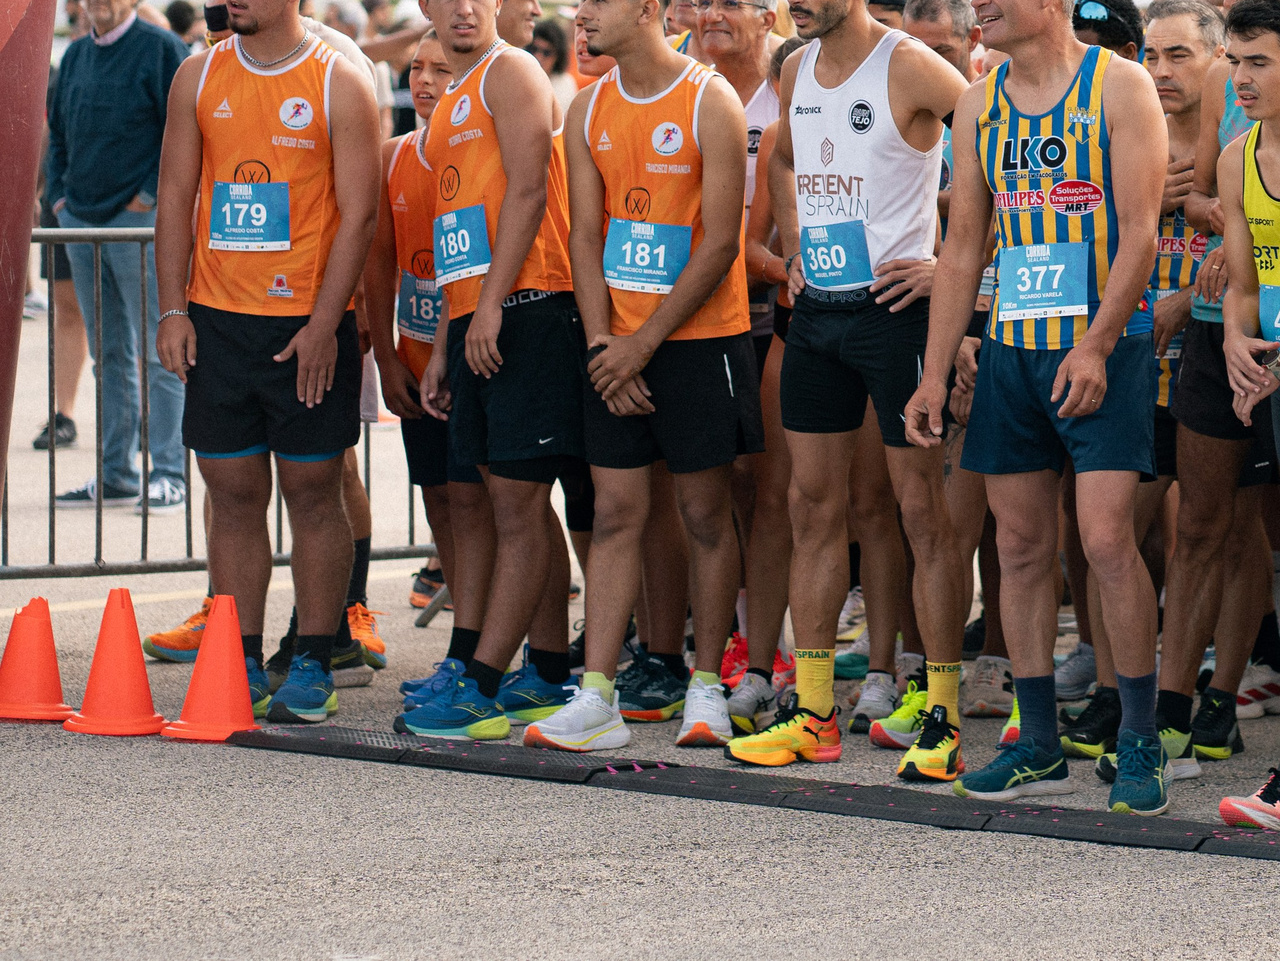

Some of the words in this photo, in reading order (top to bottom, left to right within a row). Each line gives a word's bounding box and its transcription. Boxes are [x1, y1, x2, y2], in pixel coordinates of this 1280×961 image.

[851, 115, 870, 125] TEJO
[462, 128, 484, 142] COSTA
[271, 135, 297, 148] ALFREDO
[297, 138, 316, 150] COSTA
[597, 143, 612, 151] SELECT
[1001, 135, 1068, 172] LKO
[645, 162, 668, 174] FRANCISCO
[668, 164, 691, 174] MIRANDA
[1000, 173, 1027, 181] FORMAÇÃO
[1056, 186, 1094, 195] Soluções
[1050, 193, 1101, 203] Transportes
[806, 194, 869, 220] SPRAIN
[1064, 202, 1090, 213] MRT
[222, 203, 267, 226] 179
[1255, 218, 1275, 227] SPORT
[440, 229, 470, 258] 180
[621, 241, 666, 268] 181
[807, 244, 846, 271] 360
[1026, 245, 1050, 258] CORRIDA
[617, 265, 643, 274] FRANCISCO
[643, 268, 668, 276] MIRANDA
[1016, 264, 1066, 292] 377
[829, 289, 867, 303] PRO
[1019, 292, 1042, 300] RICARDO
[1042, 291, 1063, 299] VARELA
